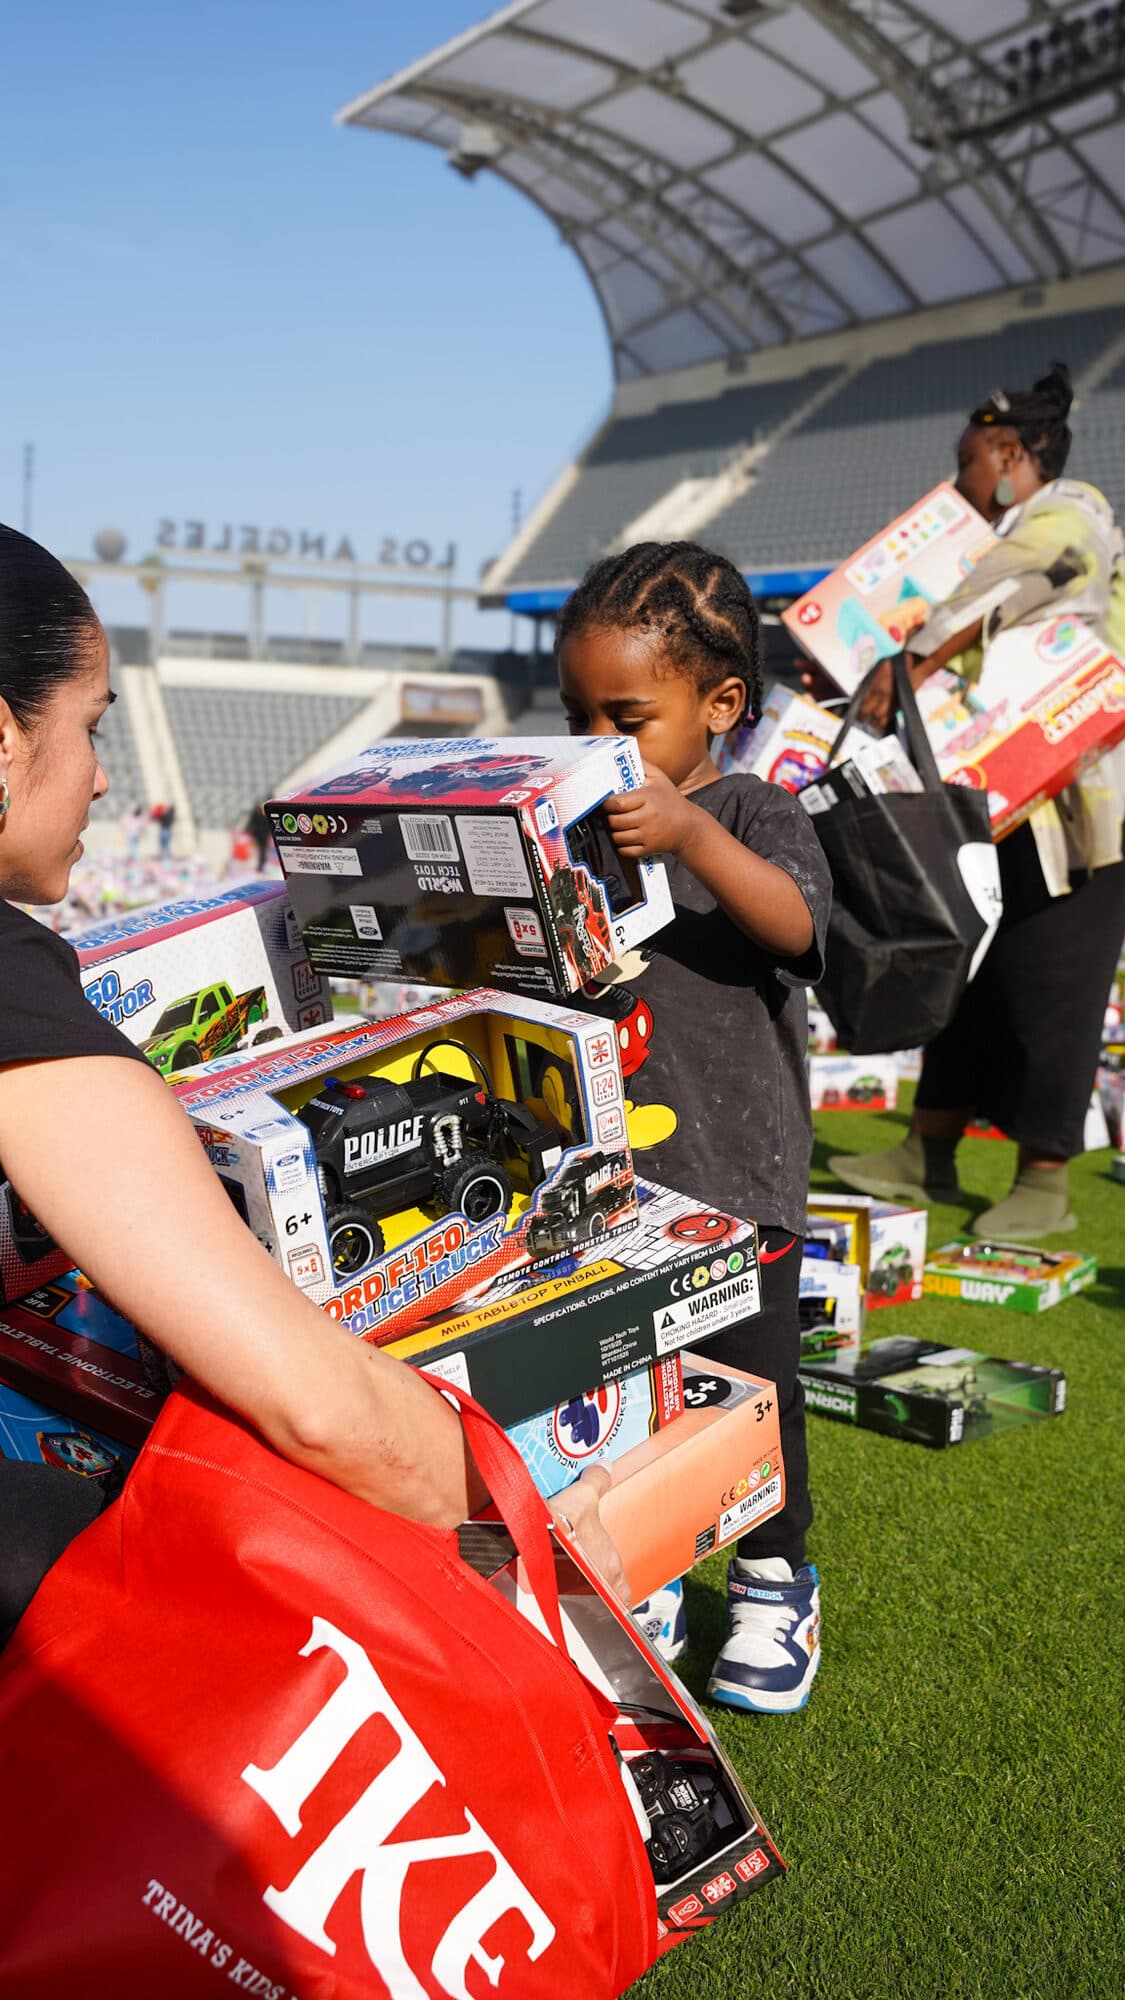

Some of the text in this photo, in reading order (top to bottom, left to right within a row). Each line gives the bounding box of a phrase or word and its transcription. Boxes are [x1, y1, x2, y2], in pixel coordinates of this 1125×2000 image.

[414, 864, 438, 876] TOYS
[418, 877, 464, 894] WORLD
[440, 866, 460, 877] TECH
[523, 925, 537, 936] 5x
[615, 925, 626, 947] 6+
[183, 1070, 261, 1106] FORD
[262, 1041, 334, 1076] F-150
[217, 1064, 300, 1102] POLICE
[302, 1033, 372, 1068] TRUCK
[595, 1075, 613, 1097] 1:24
[597, 1091, 614, 1102] SCALE
[219, 1109, 246, 1121] 6+
[344, 1115, 425, 1164] POLICE
[285, 1212, 313, 1237] 6+
[386, 1222, 466, 1289] F-150
[420, 1227, 502, 1291] TRUCK
[497, 1265, 532, 1286] REMOTE
[533, 1250, 571, 1269] CONTROL
[572, 1229, 611, 1253] MONSTER
[611, 1221, 639, 1237] TRUCK
[441, 1319, 472, 1337] MINI
[475, 1288, 549, 1322] TABLETOP
[553, 1265, 609, 1293] PINBALL
[533, 1301, 587, 1327] SPECIFICATIONS,
[587, 1287, 616, 1306] COLORS,
[616, 1281, 630, 1293] AND
[630, 1270, 659, 1288] CONTENT
[659, 1263, 673, 1277] MAY
[672, 1256, 691, 1272] VARY
[690, 1249, 708, 1264] FROM
[688, 1278, 754, 1317] WARNING:
[922, 1272, 1016, 1304] SUBWAY
[600, 1326, 640, 1346] World Tech Toys
[660, 1320, 691, 1340] CHOKING
[691, 1308, 718, 1325] HAZARD
[723, 1301, 739, 1313] Small
[664, 1306, 753, 1348] Not for children under 3 years.
[58, 1353, 156, 1399] ELECTRONIC
[602, 1354, 653, 1381] MADE IN CHINA
[754, 1400, 773, 1423] 3+
[545, 1417, 578, 1470] INCLUDES
[605, 1395, 628, 1448] PUCKS
[739, 1481, 780, 1514] WARNING:
[729, 1581, 784, 1601] PAW PATROL
[142, 1878, 286, 2000] TRINA'S KIDS
